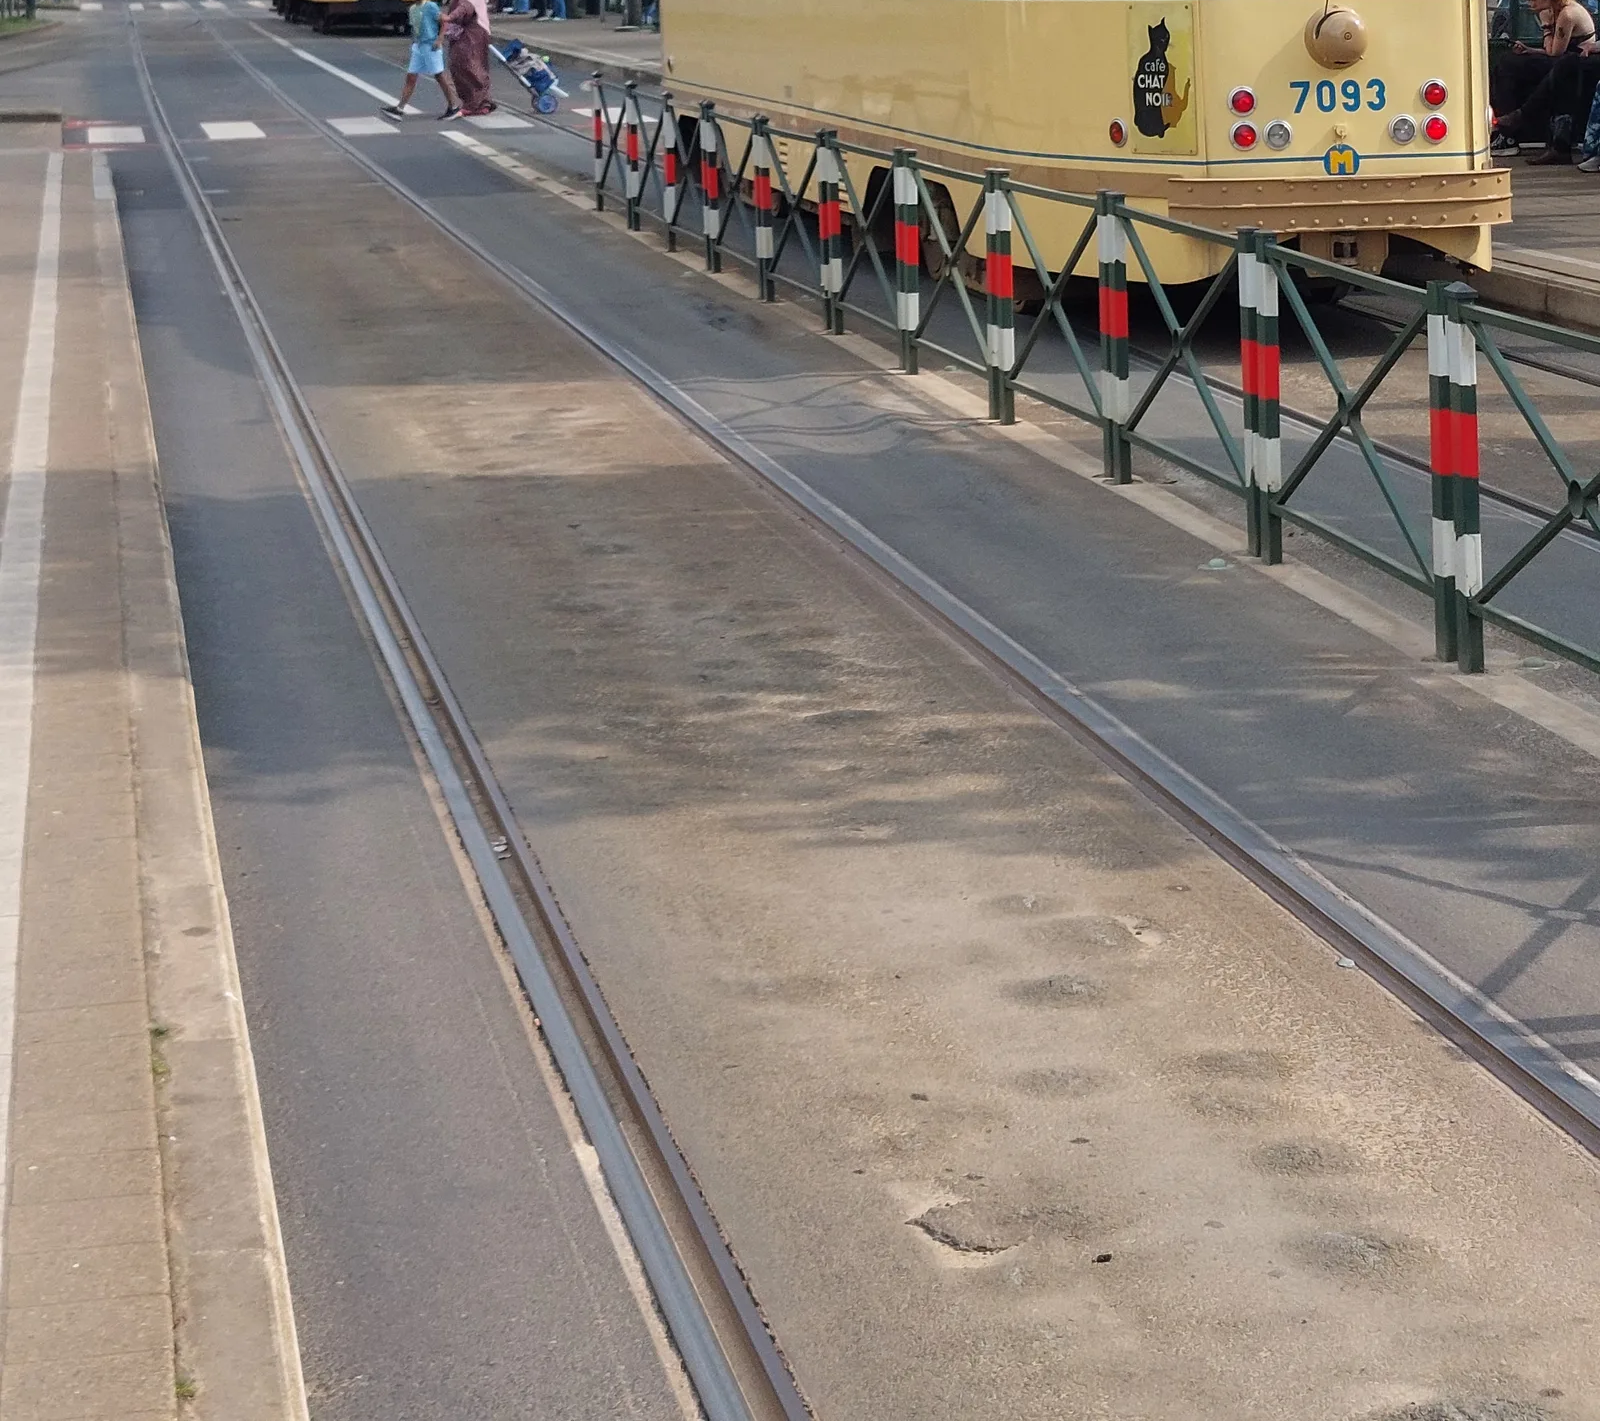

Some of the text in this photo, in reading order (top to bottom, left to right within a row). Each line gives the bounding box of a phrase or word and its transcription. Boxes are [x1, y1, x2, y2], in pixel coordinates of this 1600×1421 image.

[1137, 74, 1166, 88] CHAT
[1145, 92, 1173, 107] NOIR
[1289, 78, 1387, 114] 7093
[1329, 150, 1354, 174] M
